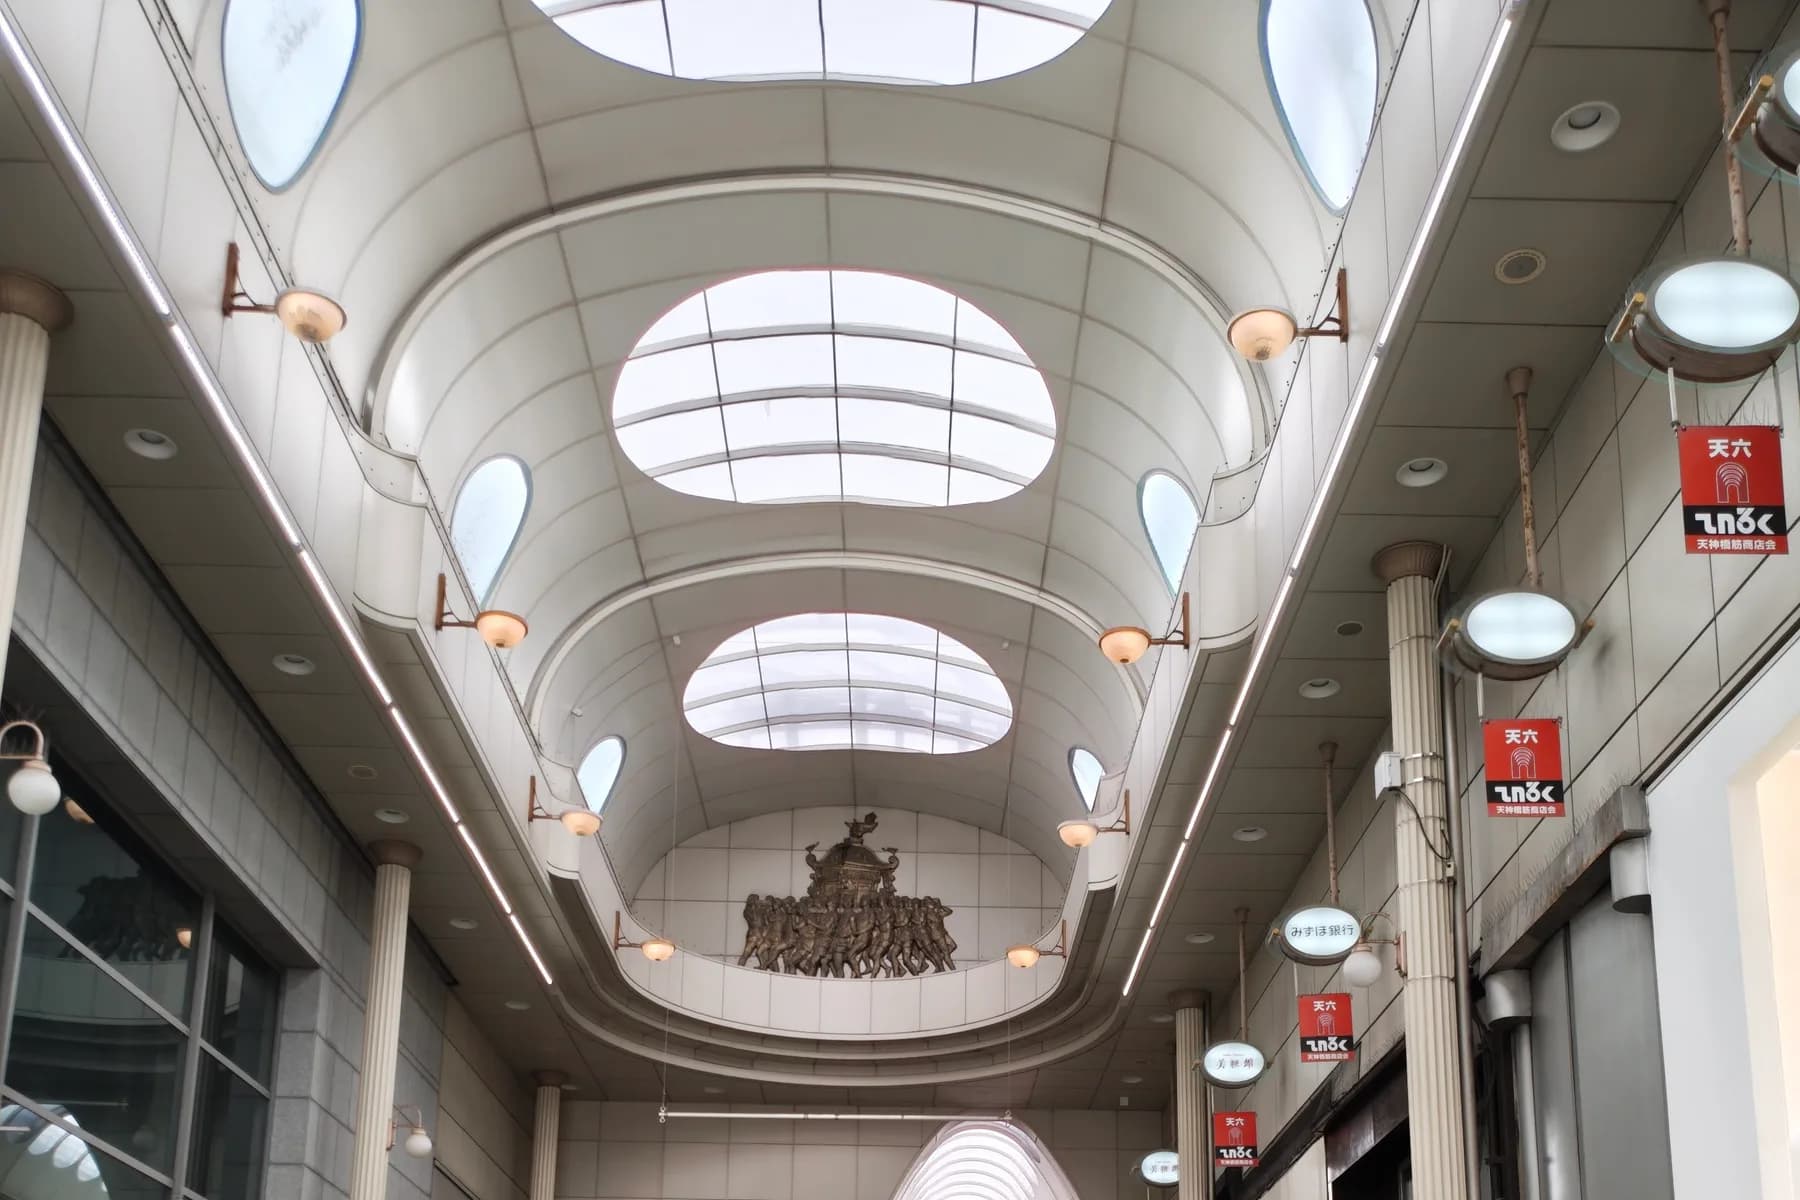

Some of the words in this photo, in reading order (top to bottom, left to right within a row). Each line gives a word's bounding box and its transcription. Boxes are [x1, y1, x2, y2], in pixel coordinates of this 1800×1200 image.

[1707, 438, 1752, 458] 天六
[1697, 539, 1777, 550] 天神橋筋商店会
[1504, 729, 1538, 744] 天六
[1291, 924, 1354, 938] みずほ銀行
[1313, 1000, 1337, 1012] 天六
[1224, 1117, 1245, 1127] 天六
